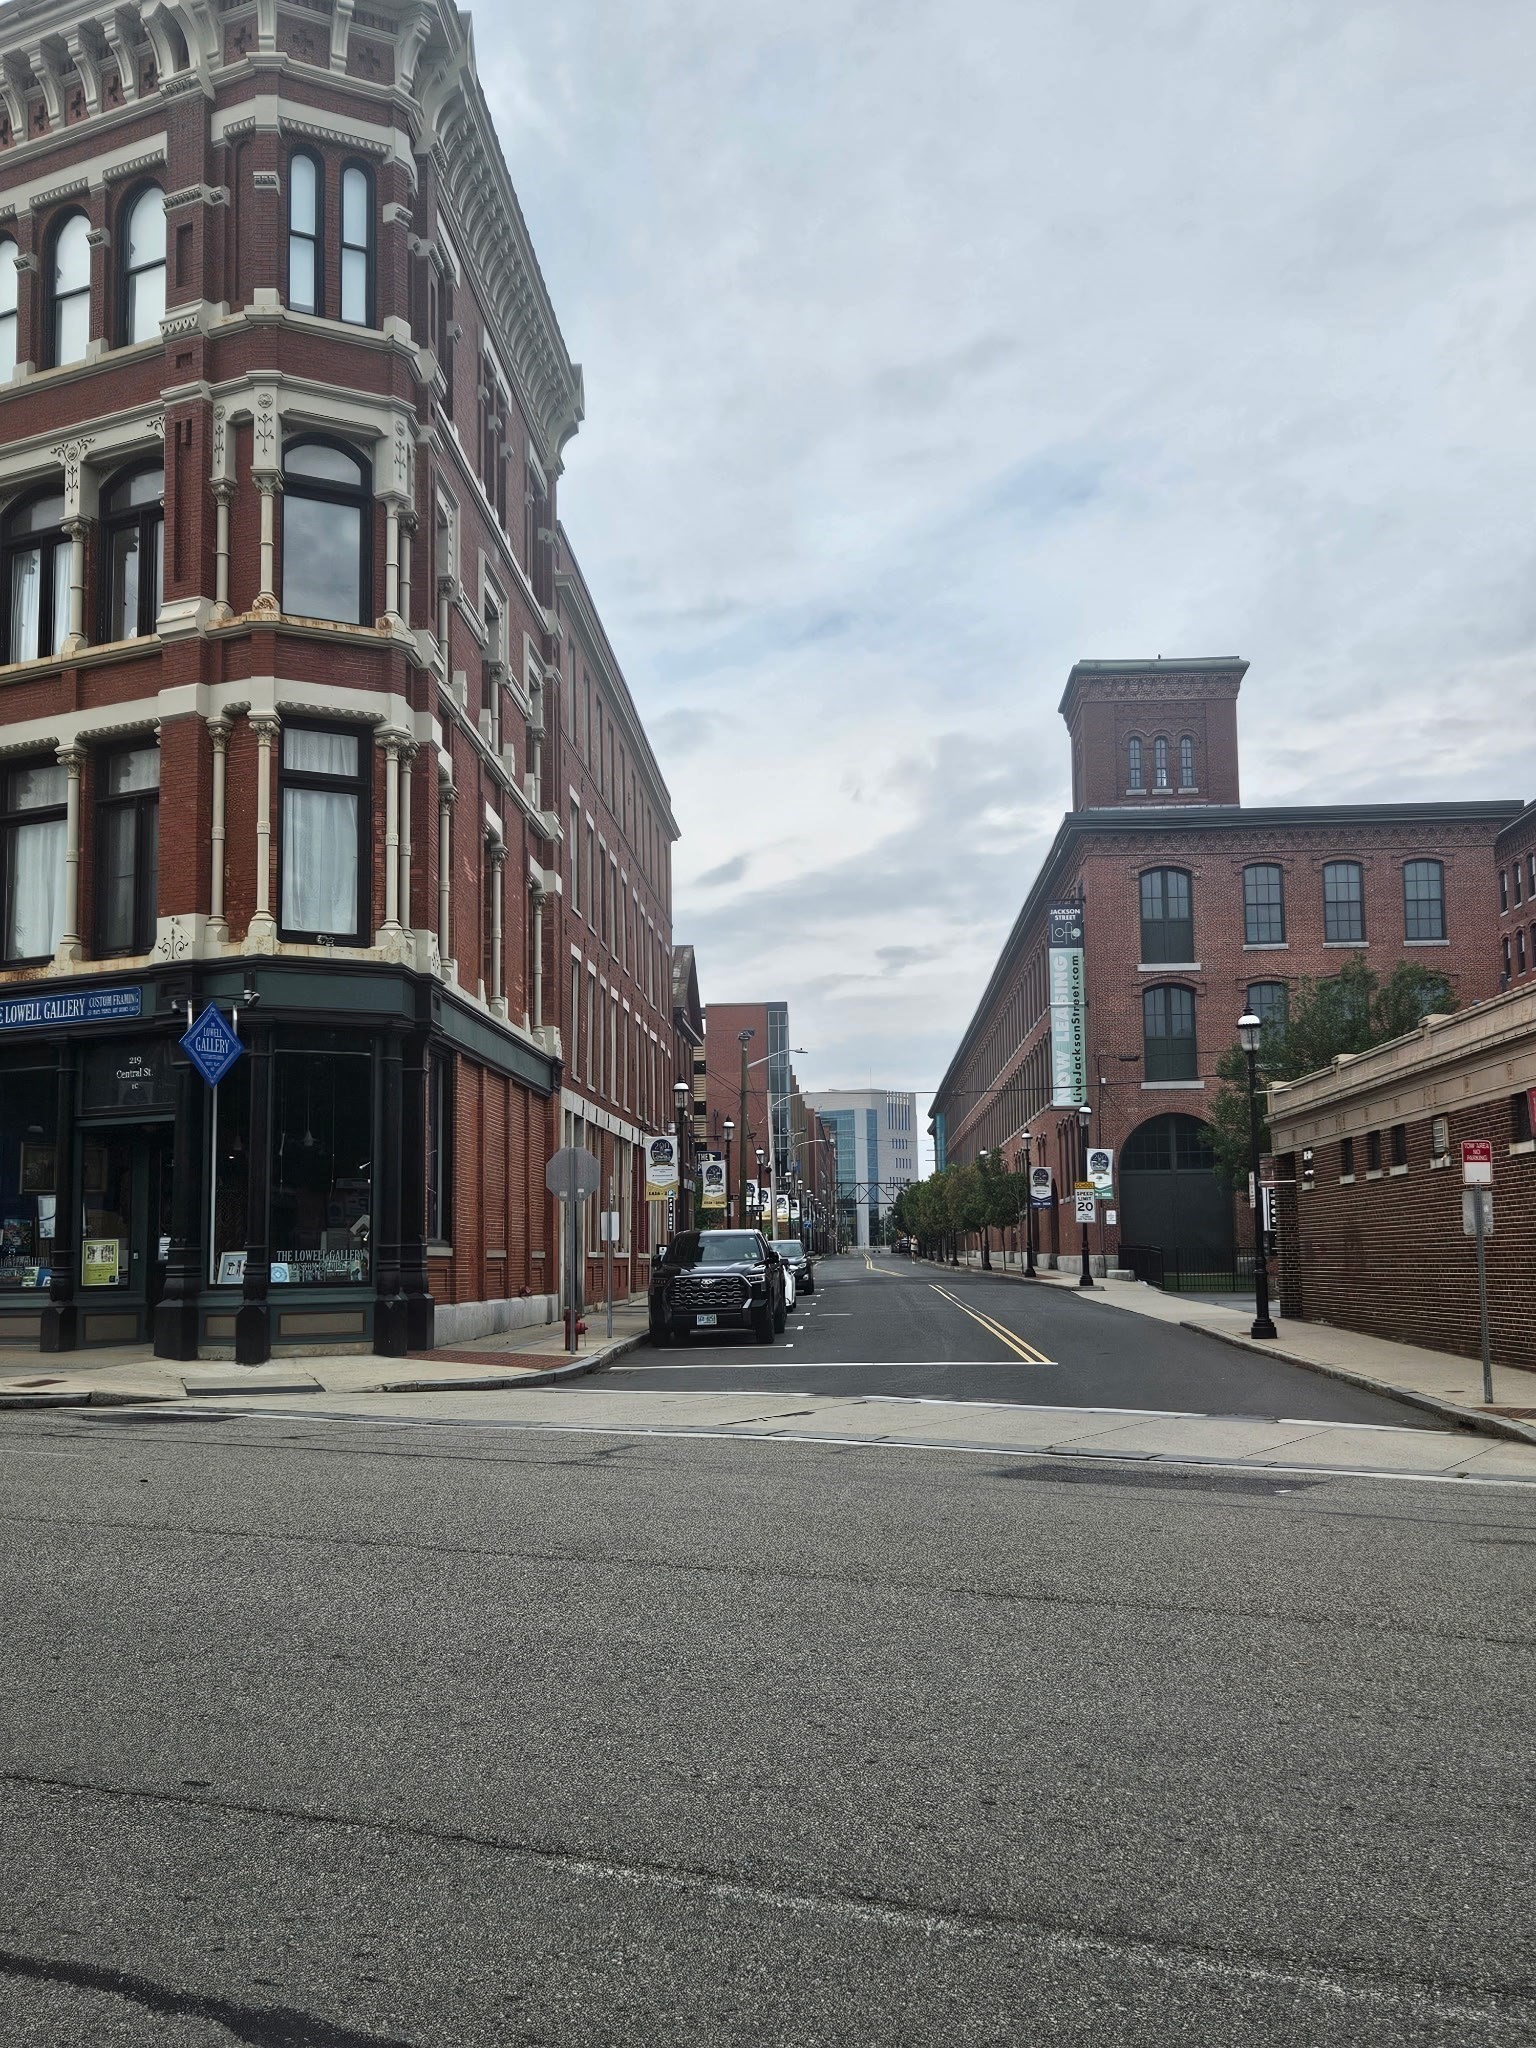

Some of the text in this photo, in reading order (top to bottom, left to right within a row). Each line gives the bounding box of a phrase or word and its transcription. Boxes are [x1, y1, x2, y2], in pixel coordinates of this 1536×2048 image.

[88, 992, 139, 1008] CUSTOM FRAMING
[5, 1003, 42, 1023] LOWELL
[44, 998, 86, 1019] GALLERY
[203, 1027, 223, 1037] LOWELL
[1053, 955, 1071, 1103] NOW LEASING
[1071, 955, 1083, 1103] LiveJacksonStreet.com
[195, 1036, 230, 1054] GALLERY
[129, 1056, 142, 1064] 219
[116, 1067, 154, 1079] Central St.
[1077, 1202, 1094, 1212] 20
[276, 1249, 364, 1261] THE LOWELL GALLERY
